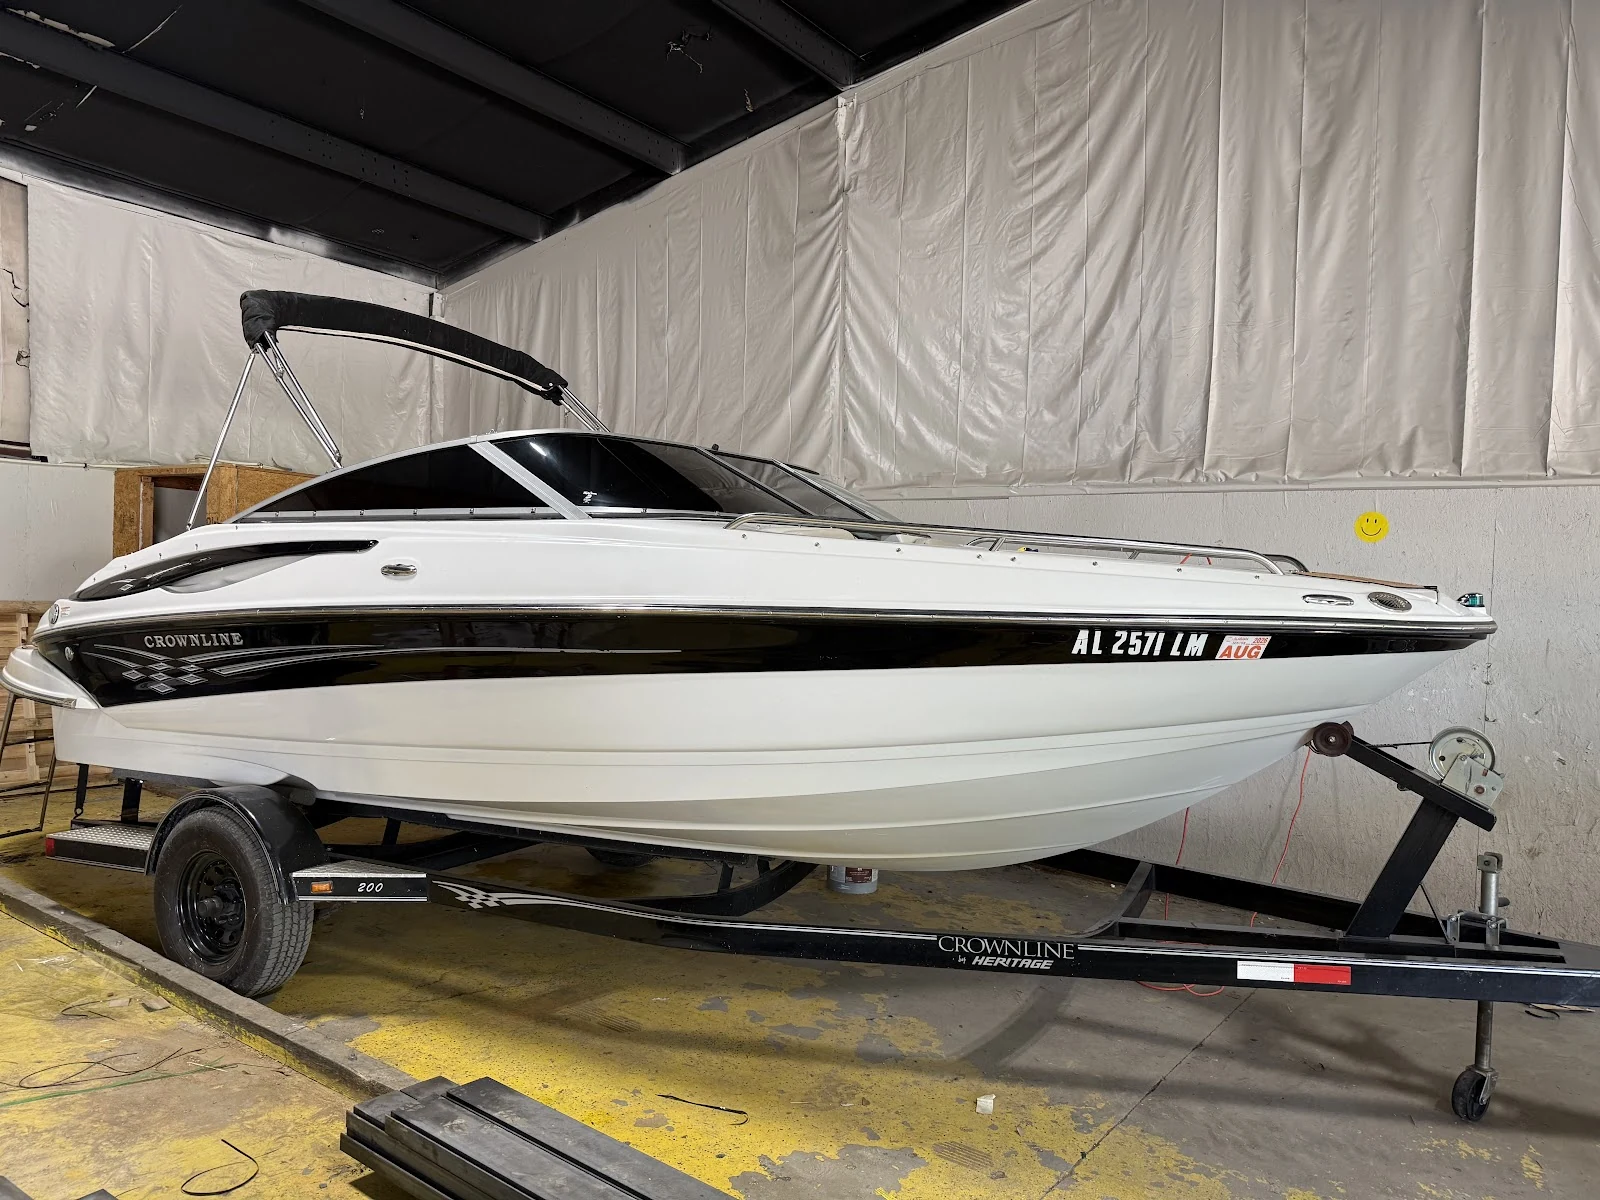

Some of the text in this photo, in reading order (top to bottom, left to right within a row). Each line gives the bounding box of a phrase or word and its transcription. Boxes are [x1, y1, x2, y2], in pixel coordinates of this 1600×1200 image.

[143, 632, 244, 649] CROWNLINE
[1071, 629, 1209, 657] AL 2571 LM
[1218, 645, 1262, 659] AUG
[357, 882, 384, 893] 200
[938, 935, 1075, 960] CROWNLINE
[971, 955, 1054, 970] HERITAGE
